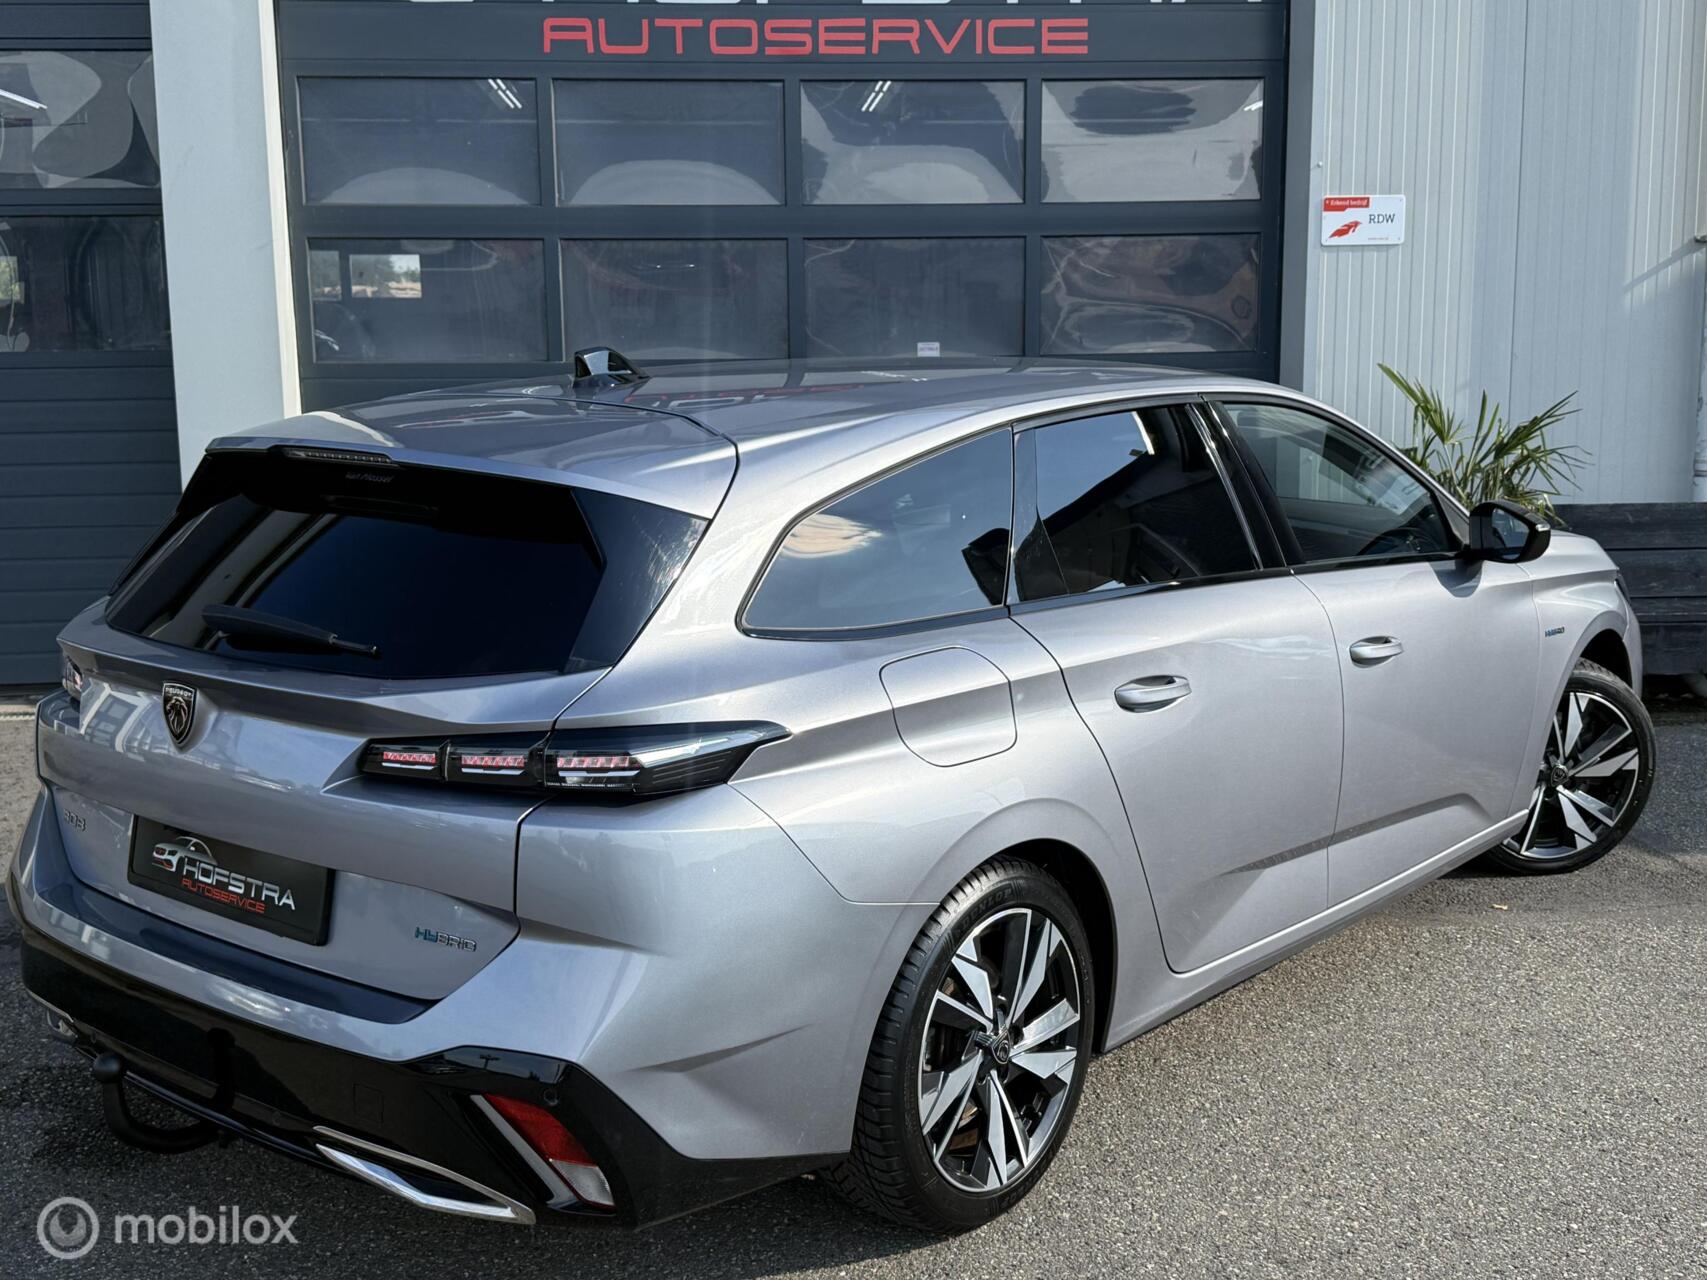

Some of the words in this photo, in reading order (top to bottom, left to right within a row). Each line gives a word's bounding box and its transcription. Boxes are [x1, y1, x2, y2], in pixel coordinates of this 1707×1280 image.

[542, 17, 1090, 55] AUTOSERVICE
[1368, 213, 1396, 224] RDW
[181, 878, 266, 914] AUTOSERVICE
[182, 856, 296, 911] HOFSTRA
